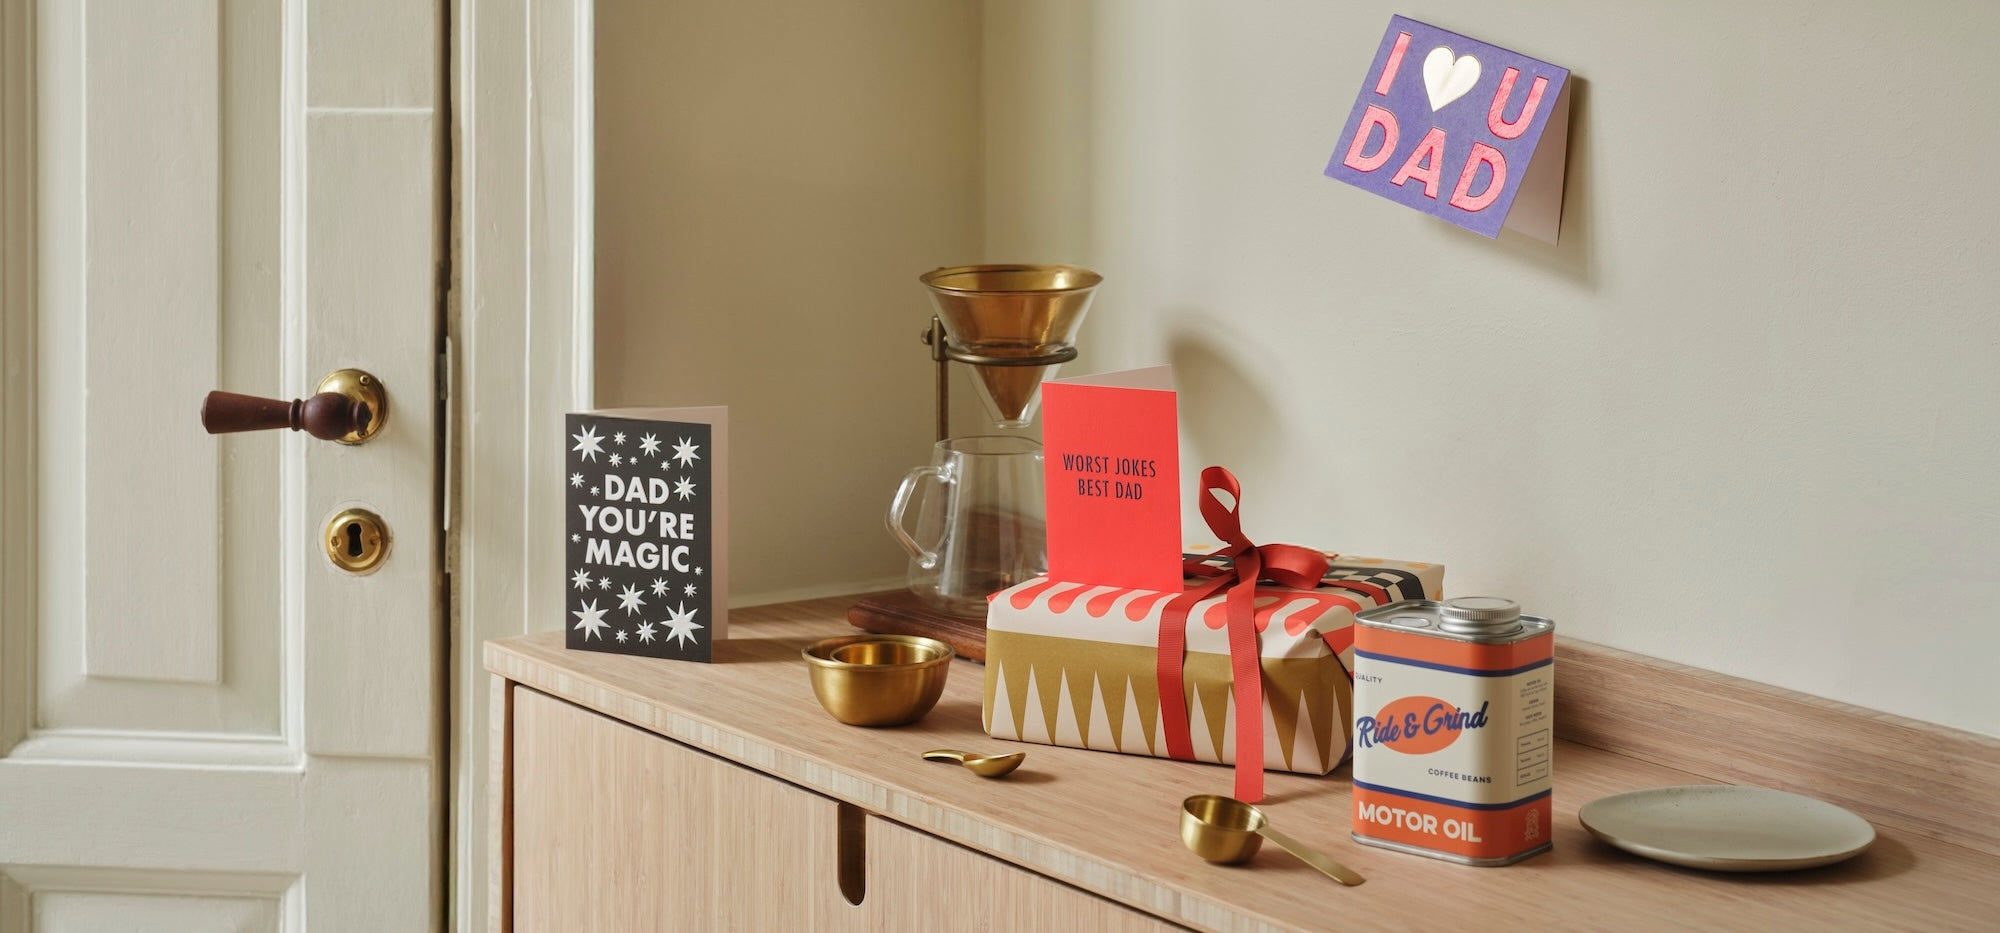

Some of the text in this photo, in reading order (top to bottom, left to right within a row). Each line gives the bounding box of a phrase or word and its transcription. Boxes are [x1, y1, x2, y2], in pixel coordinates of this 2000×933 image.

[1375, 31, 1549, 139] I U
[1343, 103, 1508, 212] DAD
[1062, 453, 1156, 478] WORST JOKES
[604, 474, 670, 505] DAD
[1078, 478, 1143, 500] BEST DAD
[578, 504, 695, 540] YOU'RE
[585, 537, 690, 573] MAGIC
[1356, 701, 1489, 749] Ride & Grind
[1428, 768, 1493, 784] COFFEE BEANS
[1358, 801, 1482, 843] MOTOR OIL
